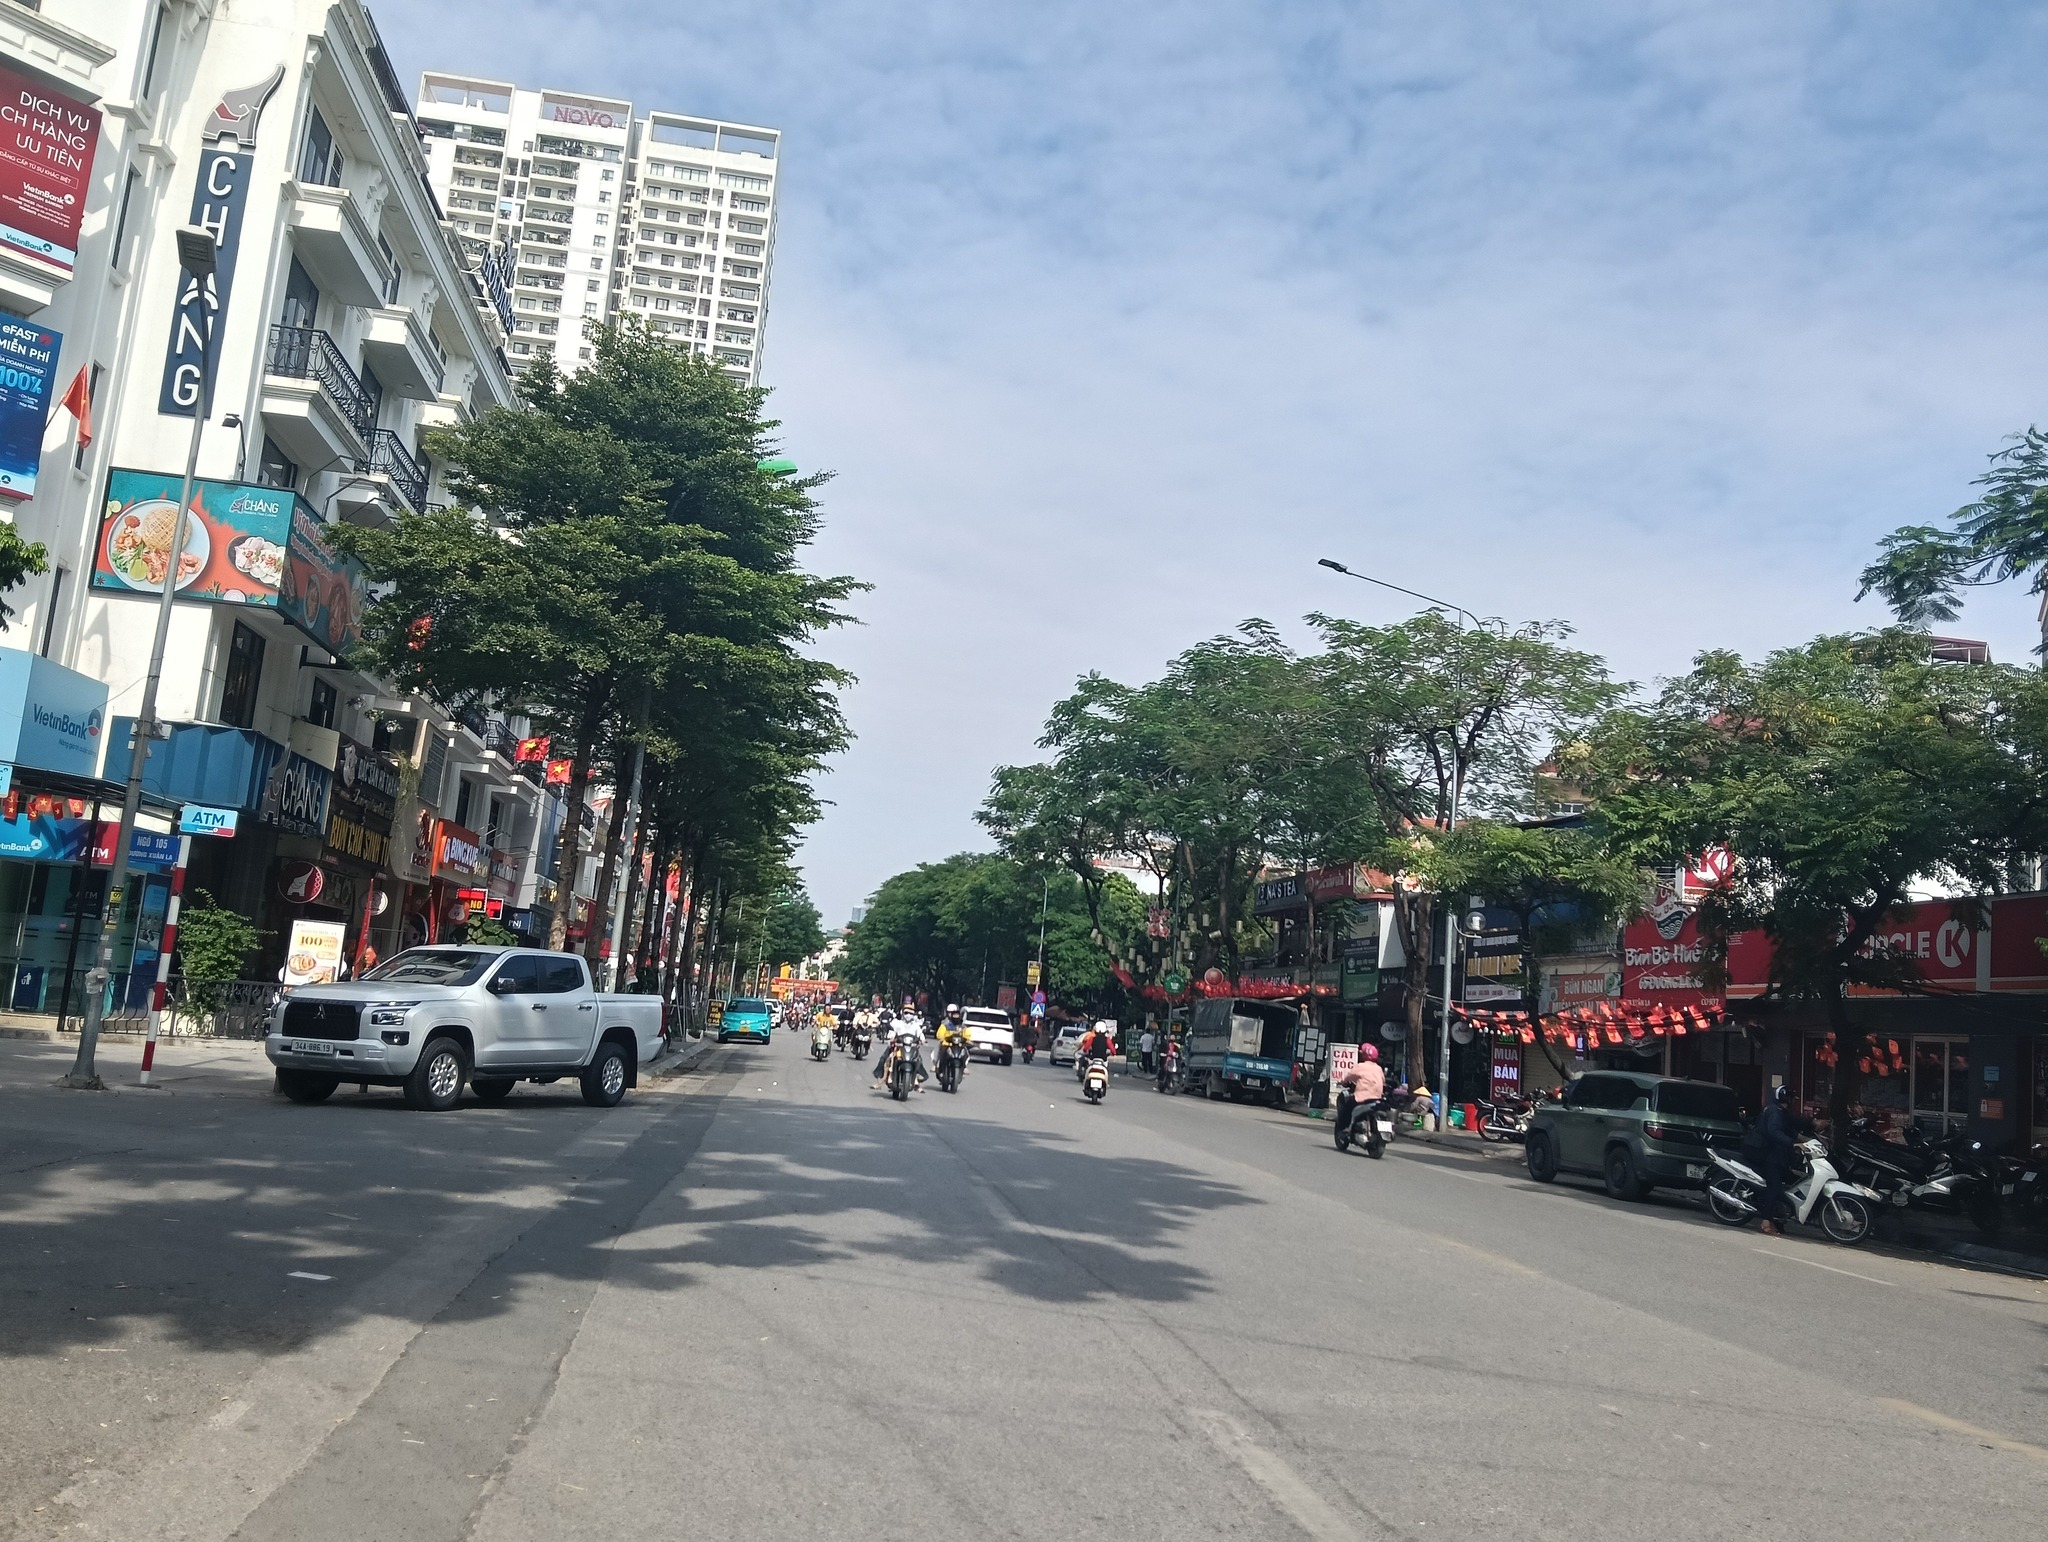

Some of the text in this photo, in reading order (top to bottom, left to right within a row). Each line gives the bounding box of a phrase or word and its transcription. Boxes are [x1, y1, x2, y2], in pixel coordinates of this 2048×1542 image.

[20, 91, 90, 133] DỊCH VỤ
[554, 106, 613, 128] NOVO
[1, 106, 86, 151] CH HÀNG
[16, 132, 82, 171] ƯU TIÊN
[23, 181, 65, 205] VietinBank
[6, 233, 43, 252] VietinBank
[2, 325, 39, 343] eFAST
[29, 348, 51, 363] PHÍ
[0, 365, 43, 395] 100%
[244, 499, 279, 513] CHANG
[34, 703, 88, 740] VietinBank
[282, 762, 322, 823] CHANG
[192, 811, 226, 827] ATM
[155, 838, 168, 849] 105
[1282, 880, 1297, 897] TEA
[508, 919, 522, 929] PNJ
[1624, 948, 1651, 966] Bún
[1651, 946, 1670, 965] Bò
[1581, 978, 1604, 994] NGAN
[1494, 1048, 1518, 1061] MUA
[1494, 1064, 1518, 1080] BÁN
